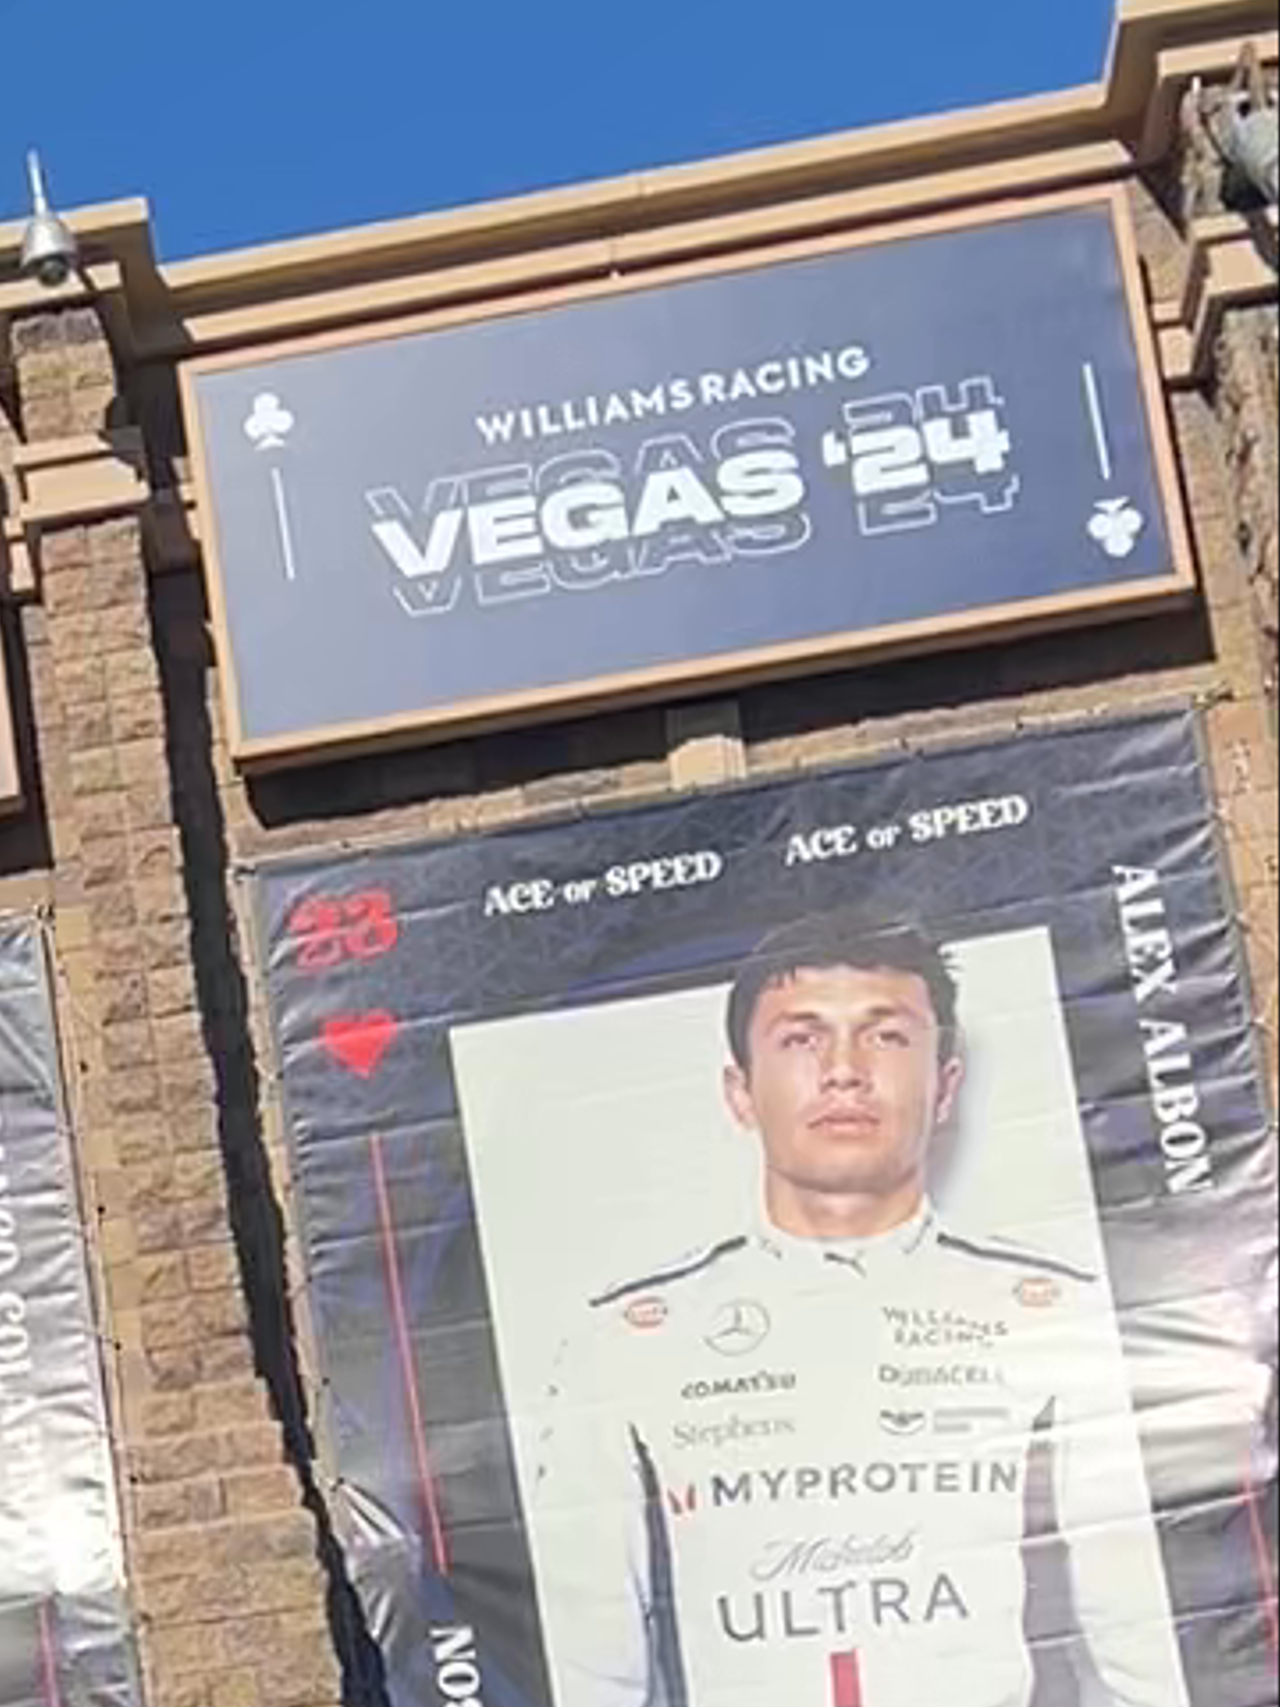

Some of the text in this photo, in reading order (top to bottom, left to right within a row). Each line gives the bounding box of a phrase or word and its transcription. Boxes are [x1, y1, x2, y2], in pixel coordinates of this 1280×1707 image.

[371, 449, 806, 581] VEGAS
[785, 825, 857, 866] ACE
[908, 795, 1029, 844] SPEED
[483, 879, 555, 916] ACE
[605, 851, 723, 898] SPEED
[1112, 865, 1214, 1194] ALEX ALBON
[711, 1461, 1019, 1508] MYPROTEIN
[717, 1572, 971, 1642] ULTRA
